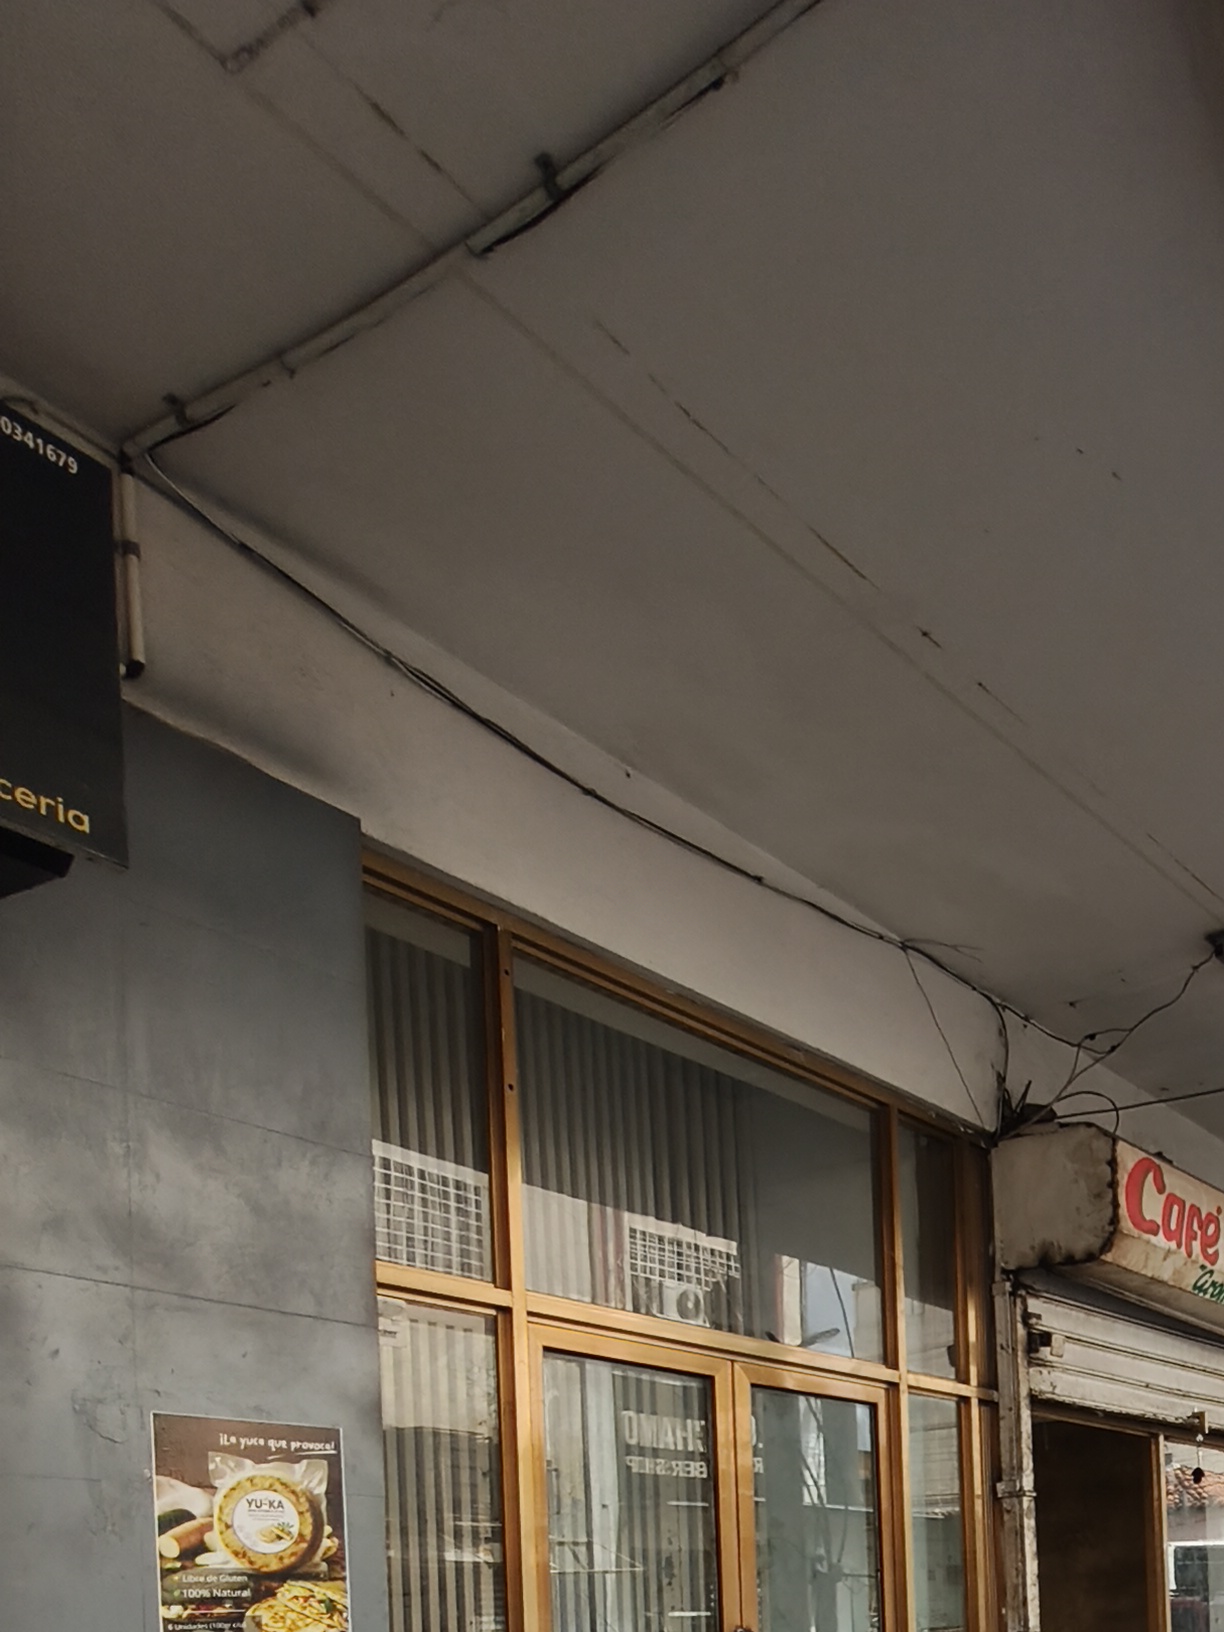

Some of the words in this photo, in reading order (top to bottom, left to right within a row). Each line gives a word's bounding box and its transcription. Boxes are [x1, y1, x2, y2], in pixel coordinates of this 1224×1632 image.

[0, 416, 78, 474] 0341679
[1125, 1157, 1222, 1266] Café
[182, 1588, 211, 1599] 100%
[212, 1588, 251, 1598] Natural
[219, 1574, 248, 1583] Gluten
